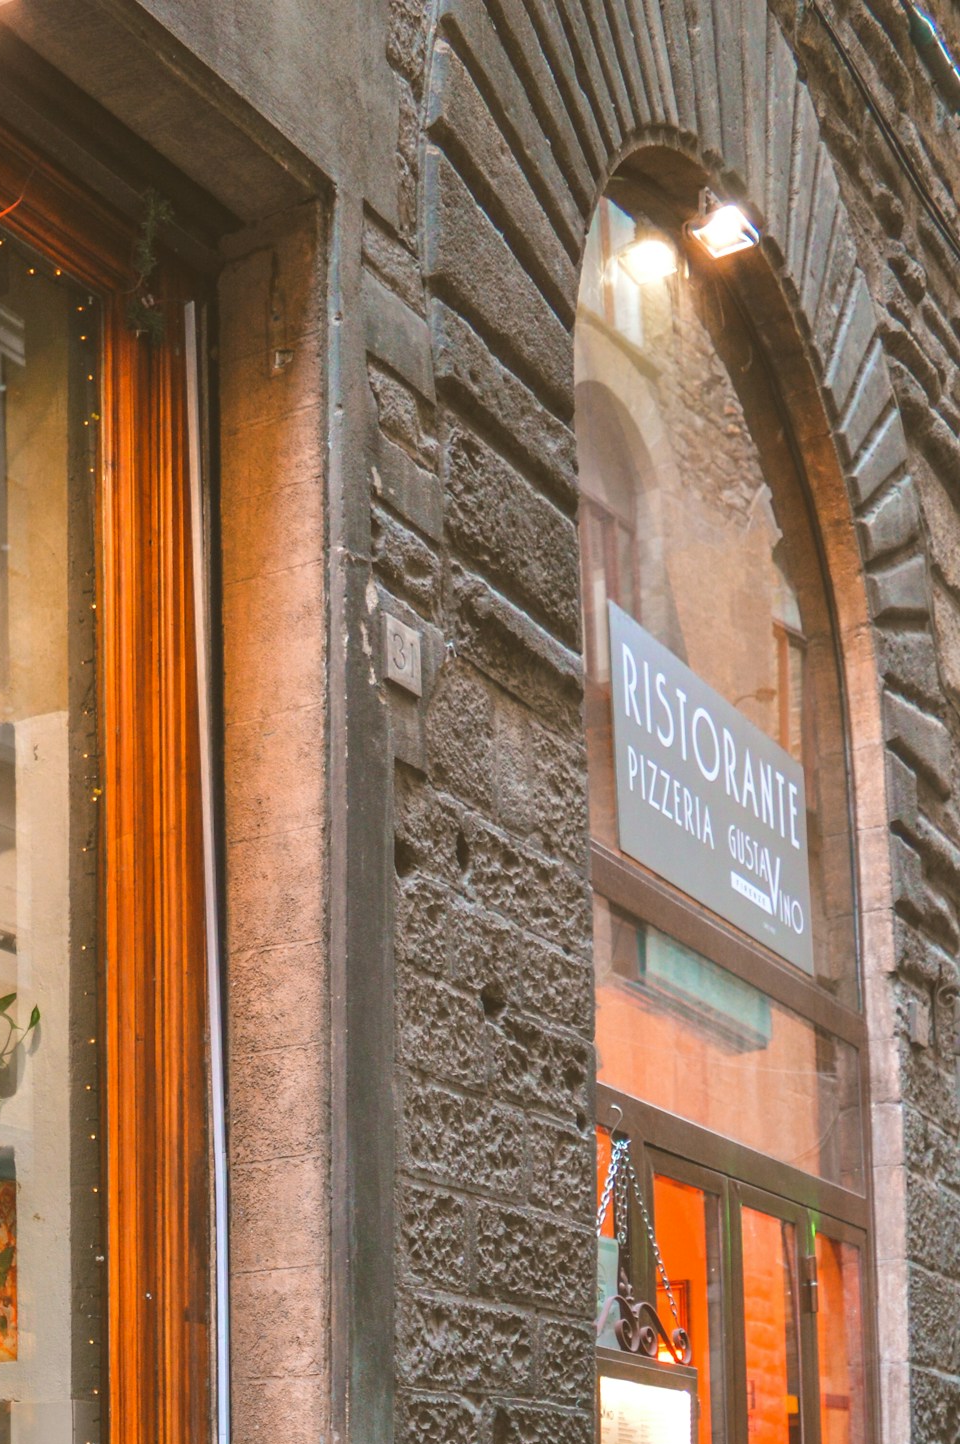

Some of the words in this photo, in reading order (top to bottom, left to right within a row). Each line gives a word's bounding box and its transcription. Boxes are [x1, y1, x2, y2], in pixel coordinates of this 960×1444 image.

[392, 633, 415, 679] 31
[621, 642, 800, 850] RISTORANTE
[627, 745, 715, 850] PIZZERIA
